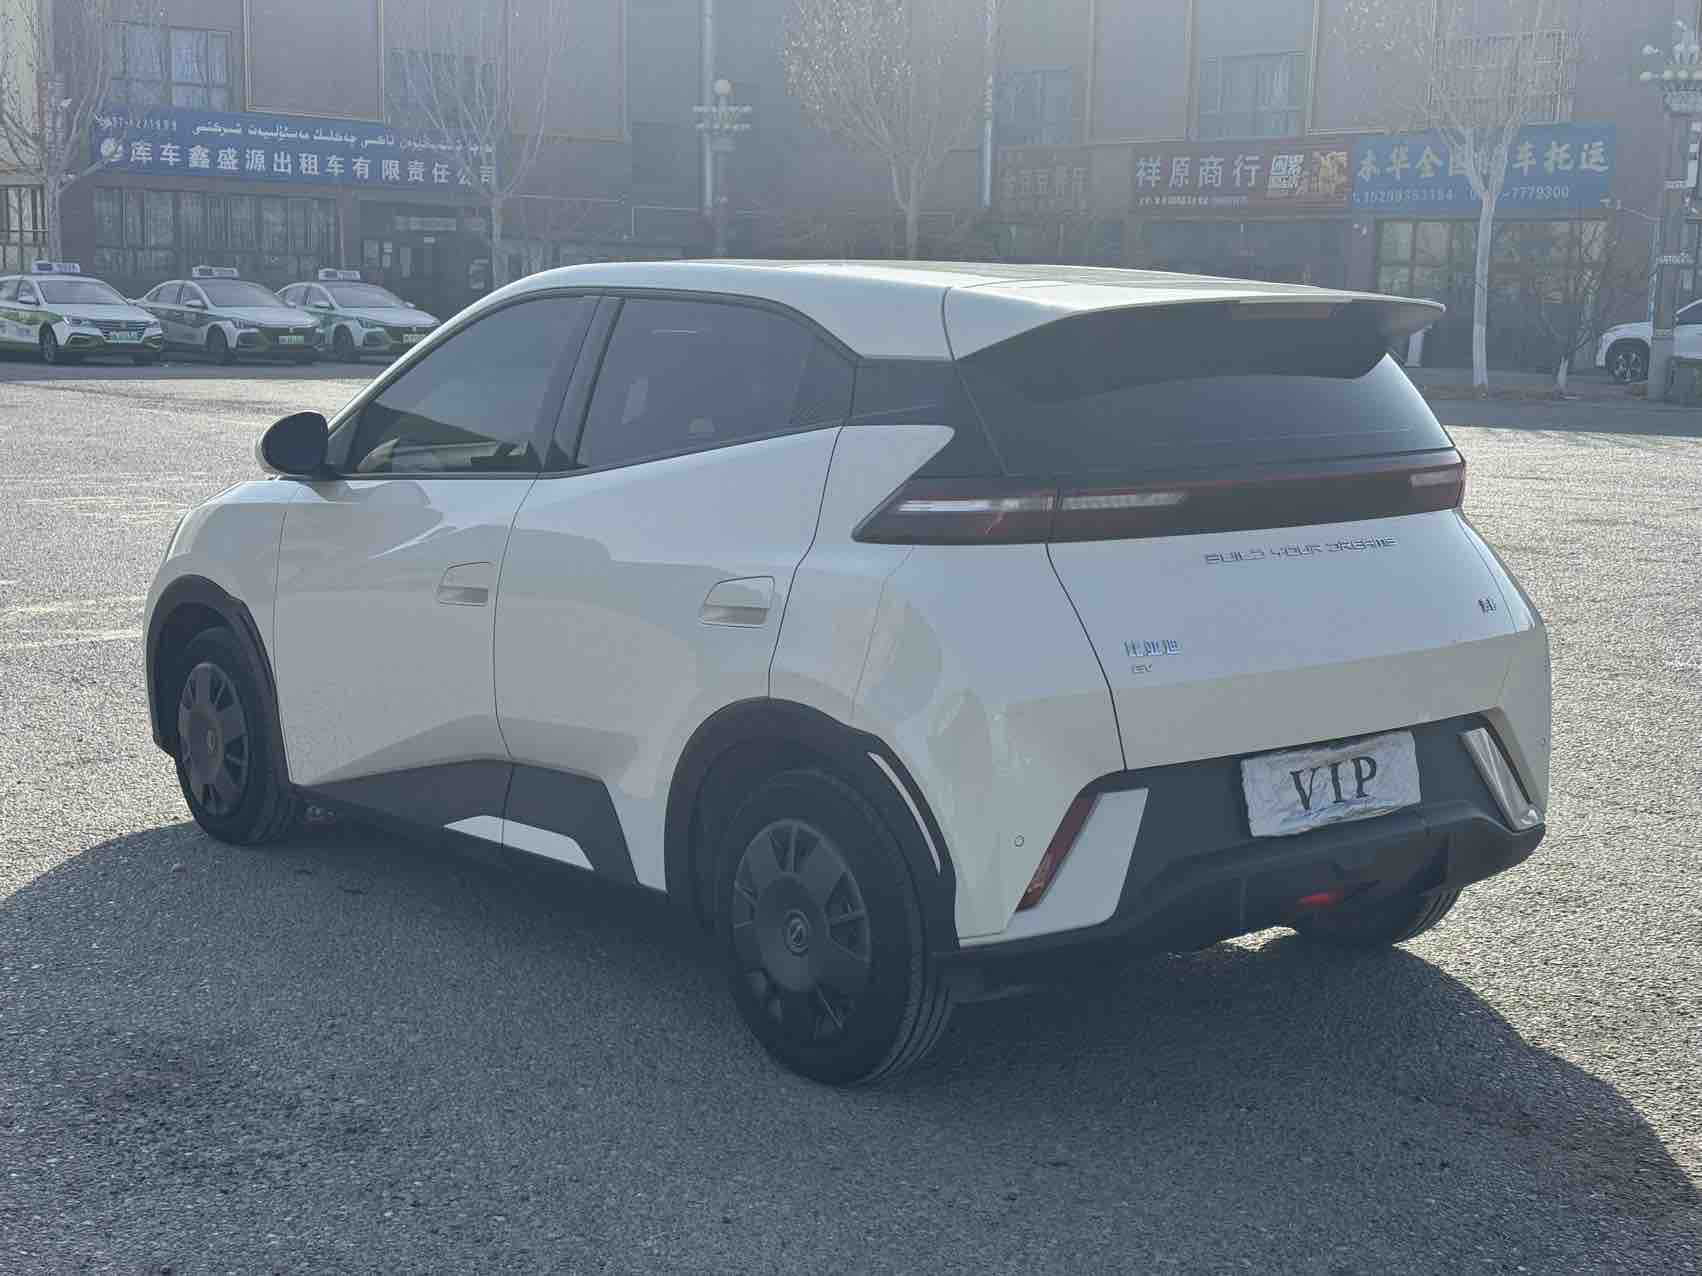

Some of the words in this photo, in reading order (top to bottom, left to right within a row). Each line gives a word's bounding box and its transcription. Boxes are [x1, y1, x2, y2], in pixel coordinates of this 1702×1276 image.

[129, 138, 497, 185] 库车鑫盛源出租车有限责任公司
[1135, 153, 1262, 188] 祥原商行
[1289, 756, 1377, 811] VIP
